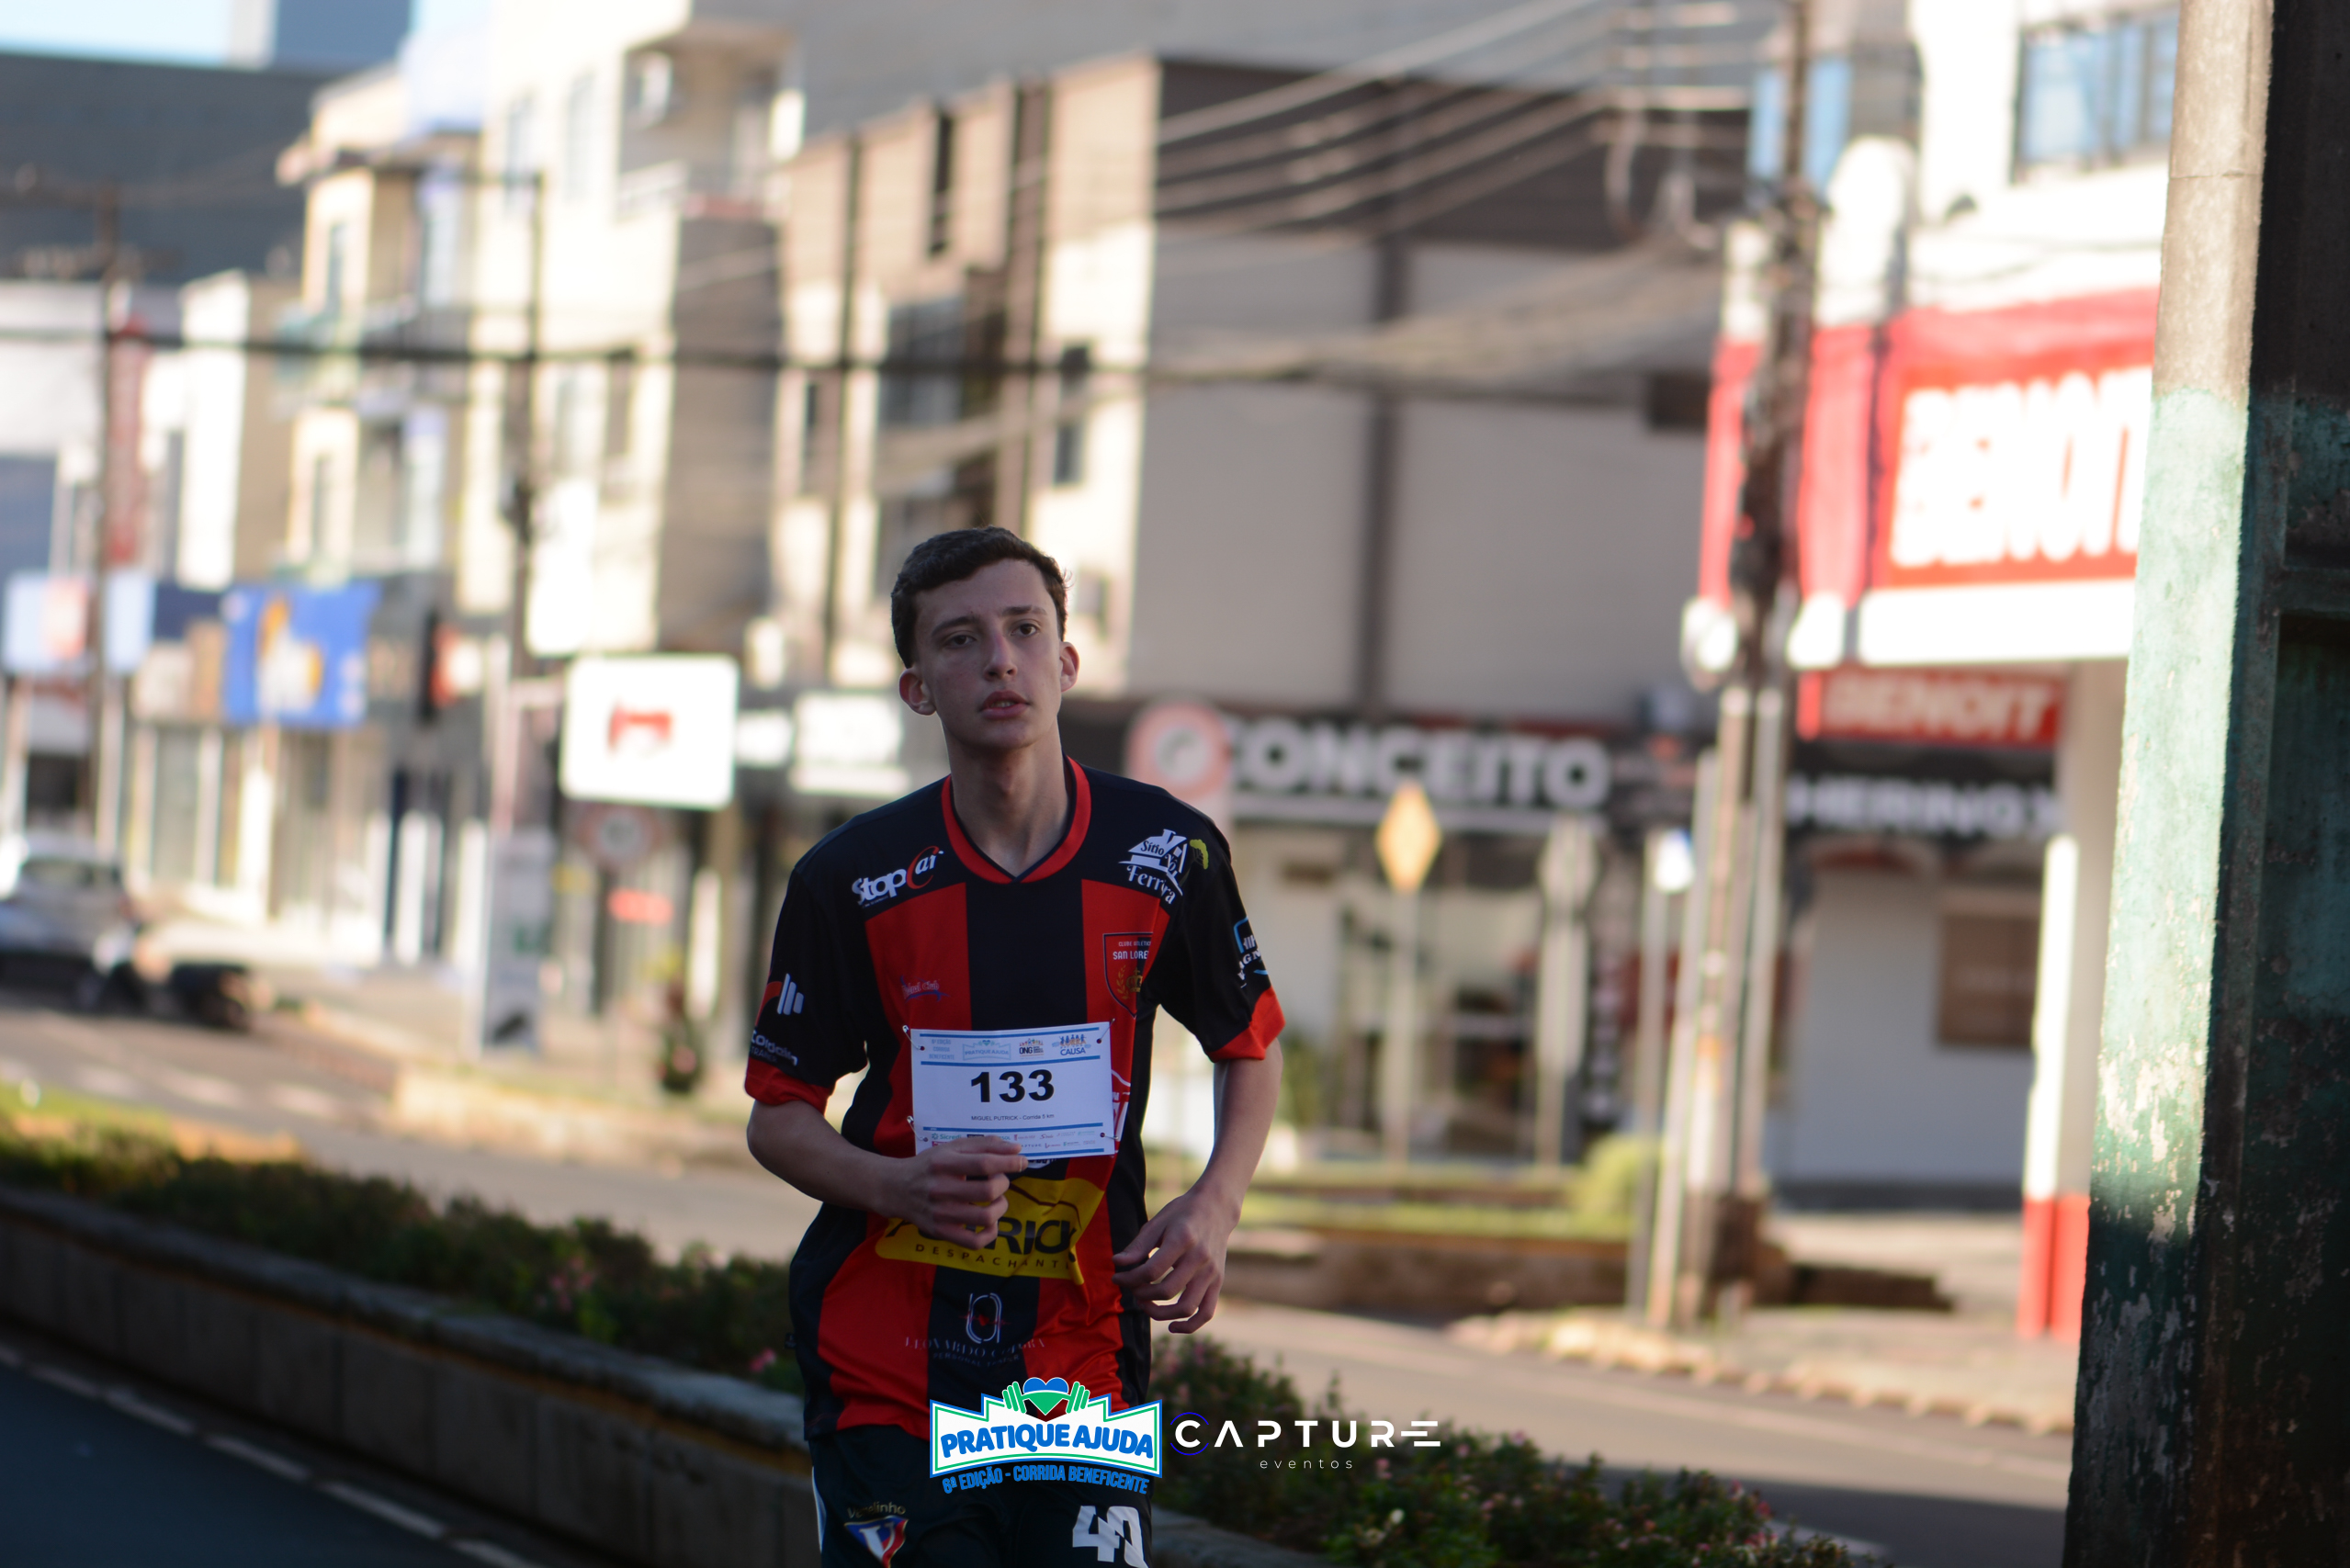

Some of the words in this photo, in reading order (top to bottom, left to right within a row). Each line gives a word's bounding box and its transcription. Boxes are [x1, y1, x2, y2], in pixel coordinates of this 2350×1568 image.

[1824, 672, 2052, 739] BENOIT
[1225, 716, 1611, 809] ONCEITO
[1140, 840, 1165, 855] Sítio
[1113, 950, 1128, 960] SAN
[1019, 1046, 1034, 1055] ONG
[1060, 1047, 1087, 1055] CAUSA
[971, 1069, 1055, 1103] 133
[933, 1351, 981, 1367] PERSONAL
